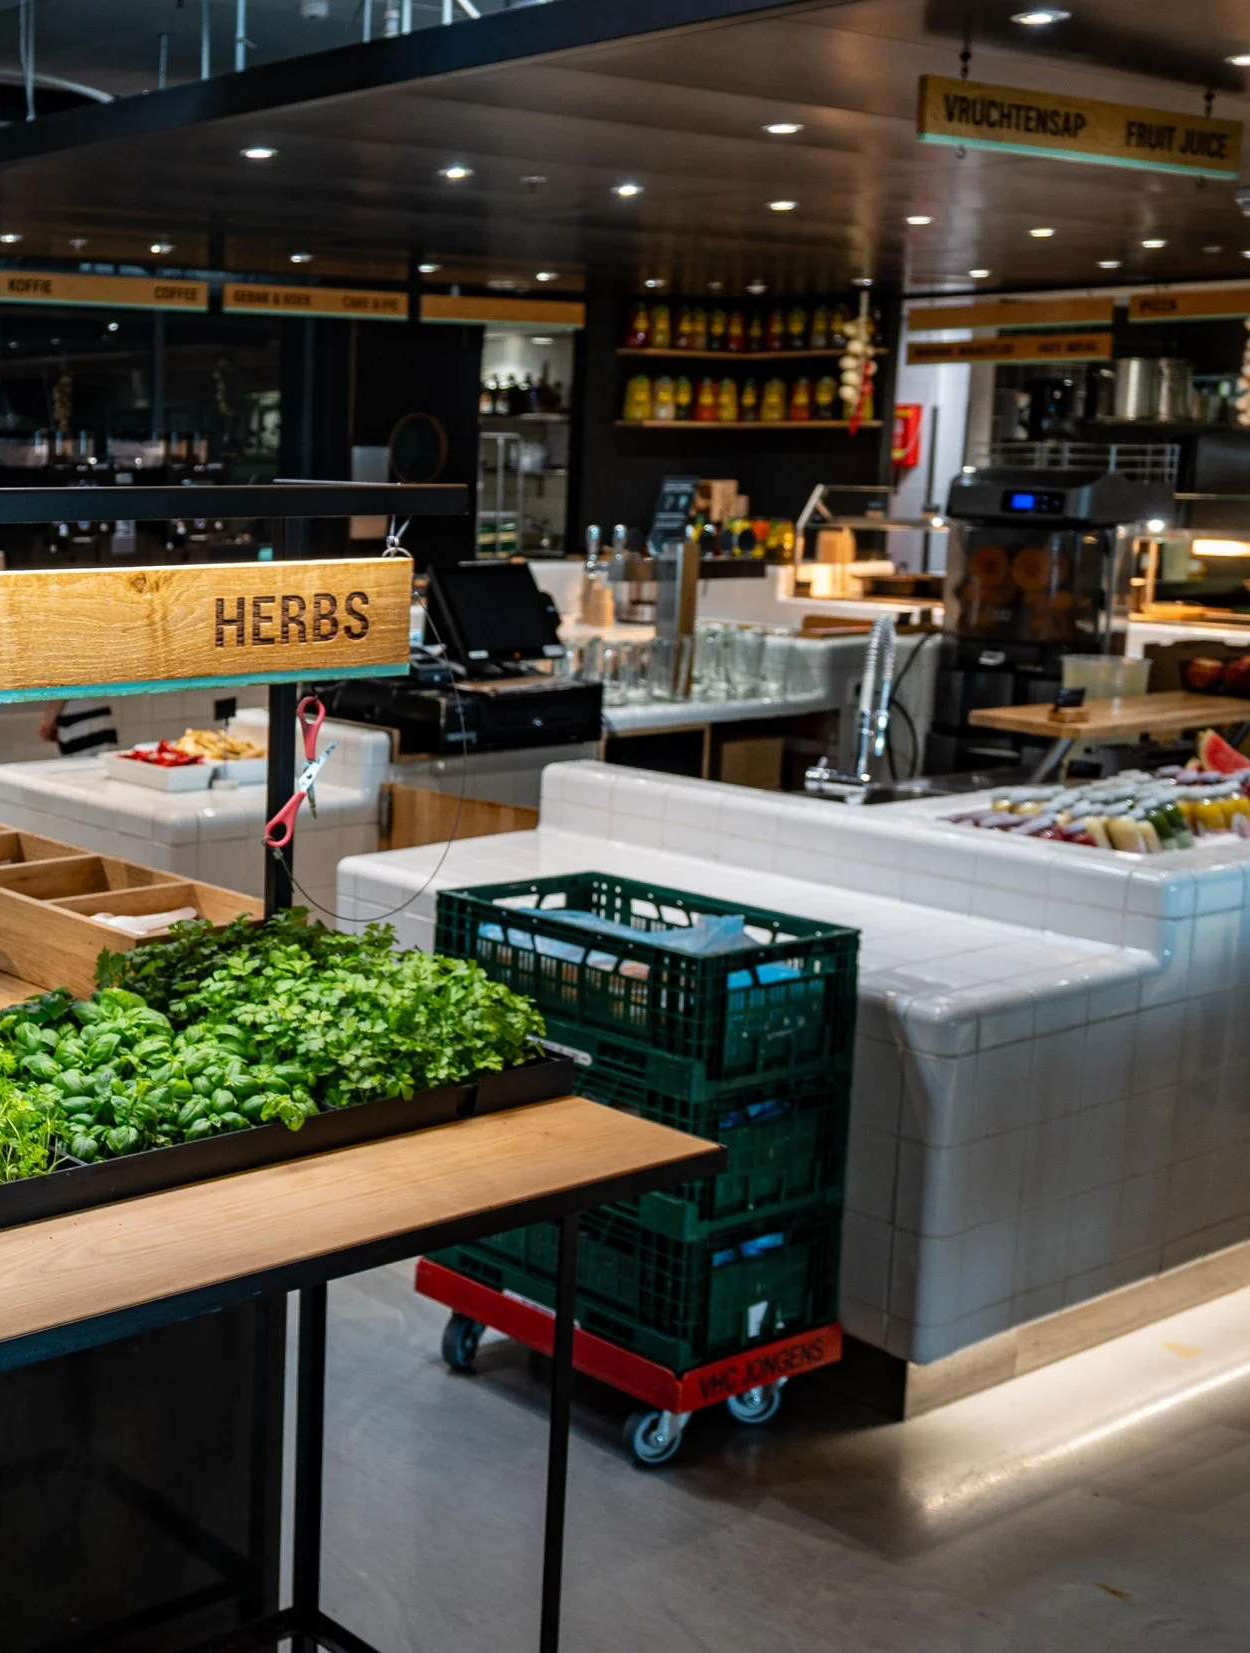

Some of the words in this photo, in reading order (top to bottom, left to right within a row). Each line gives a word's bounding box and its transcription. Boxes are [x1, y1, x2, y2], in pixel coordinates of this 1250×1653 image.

[943, 93, 1087, 139] VRUCHTENSAP
[1124, 120, 1177, 152] FRUIT
[1179, 130, 1229, 160] JUICE
[7, 278, 53, 295] KOFFIE
[153, 285, 199, 302] COFFEE
[215, 591, 370, 648] HERBS
[699, 1367, 738, 1399] VHC
[743, 1337, 823, 1384] JONGENS
